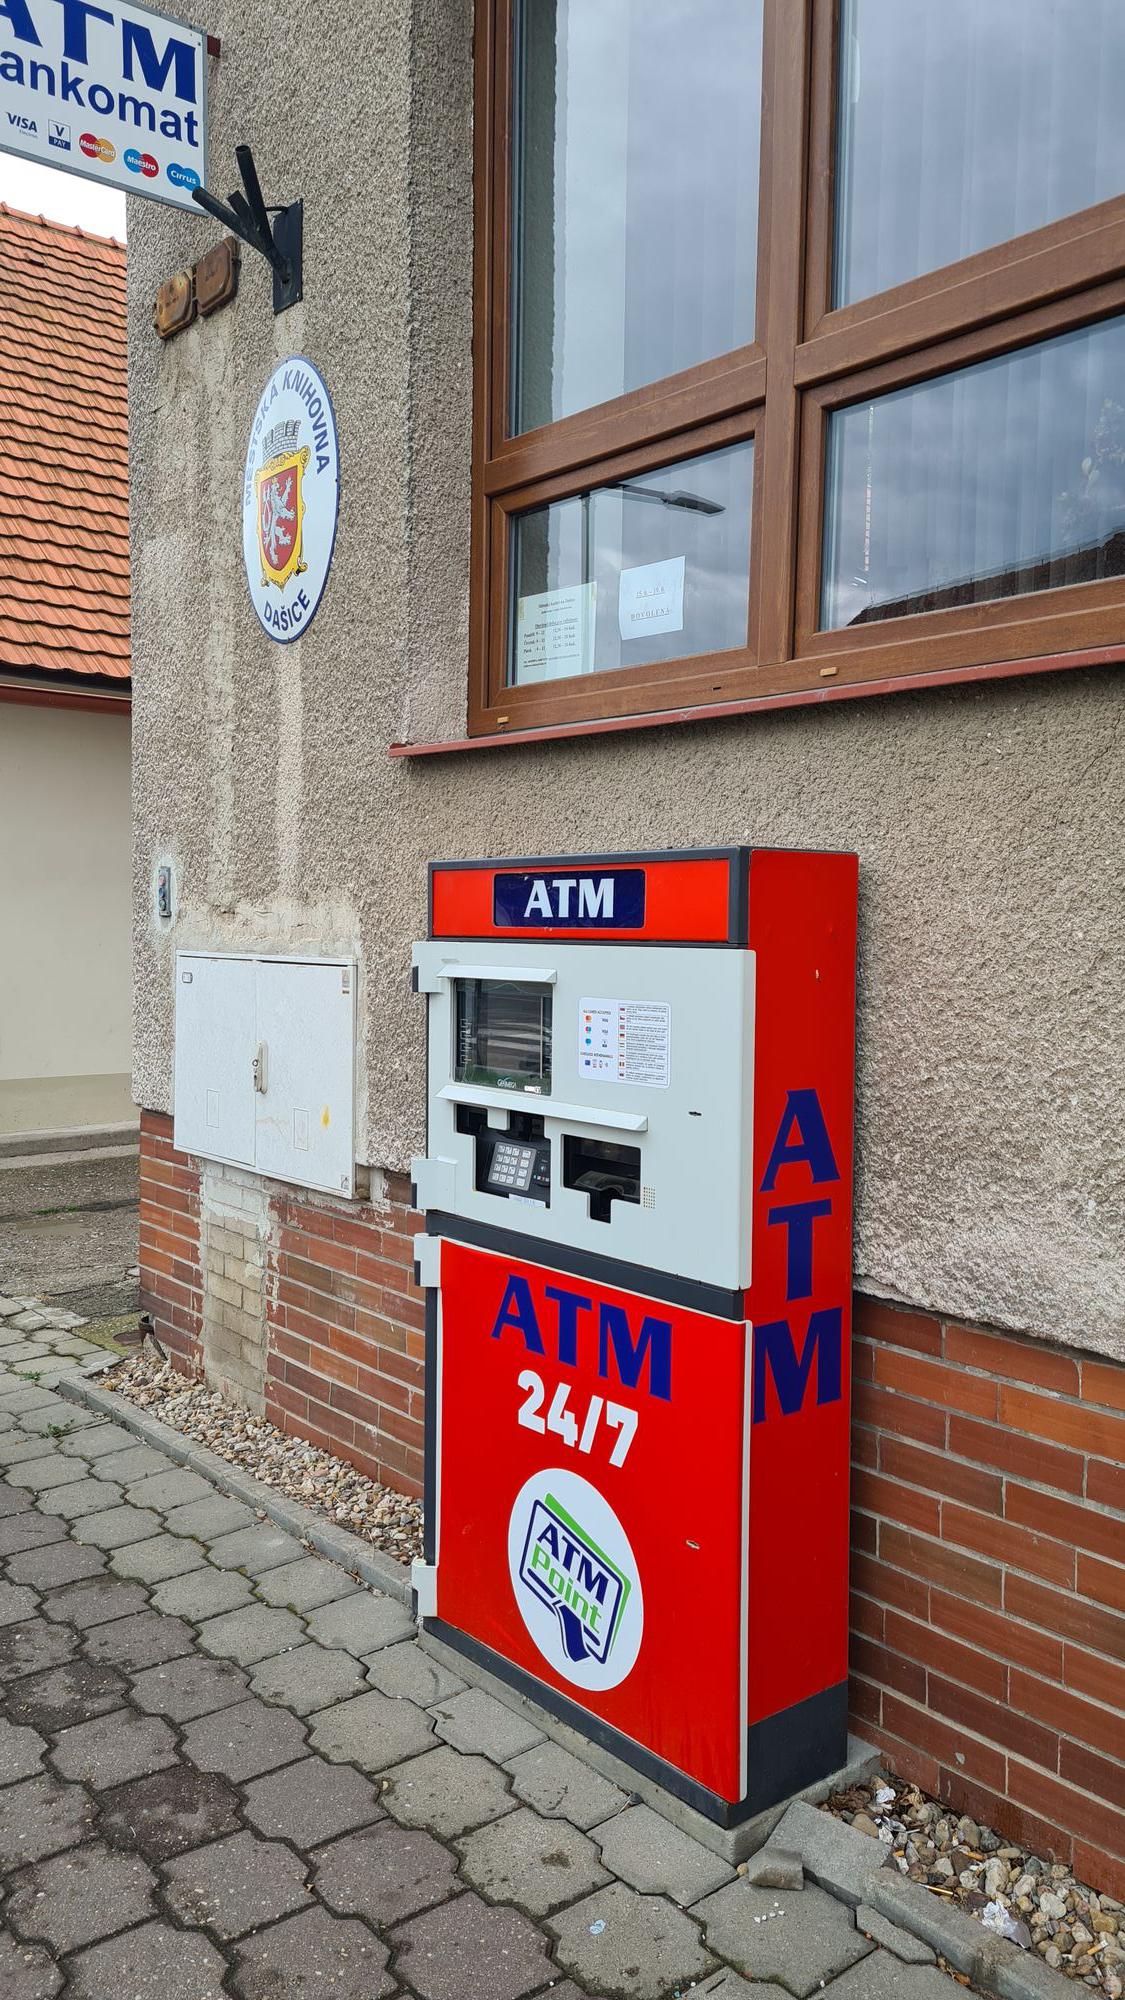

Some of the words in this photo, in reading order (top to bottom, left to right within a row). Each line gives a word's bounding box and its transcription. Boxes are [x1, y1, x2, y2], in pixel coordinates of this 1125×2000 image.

[5, 111, 38, 133] VISA
[53, 124, 65, 137] V
[53, 138, 67, 148] PAY
[80, 139, 115, 158] MasterCard
[127, 155, 156, 171] Maestro
[170, 169, 197, 185] Cirrus
[282, 370, 330, 474] KNIHOVNA
[264, 588, 310, 631] DAŠICE
[523, 878, 614, 918] ATM
[753, 1088, 843, 1424] ATM
[491, 1273, 672, 1402] ATM
[517, 1369, 638, 1468] 24/7
[537, 1522, 609, 1605] ATM
[530, 1543, 603, 1634] Point
